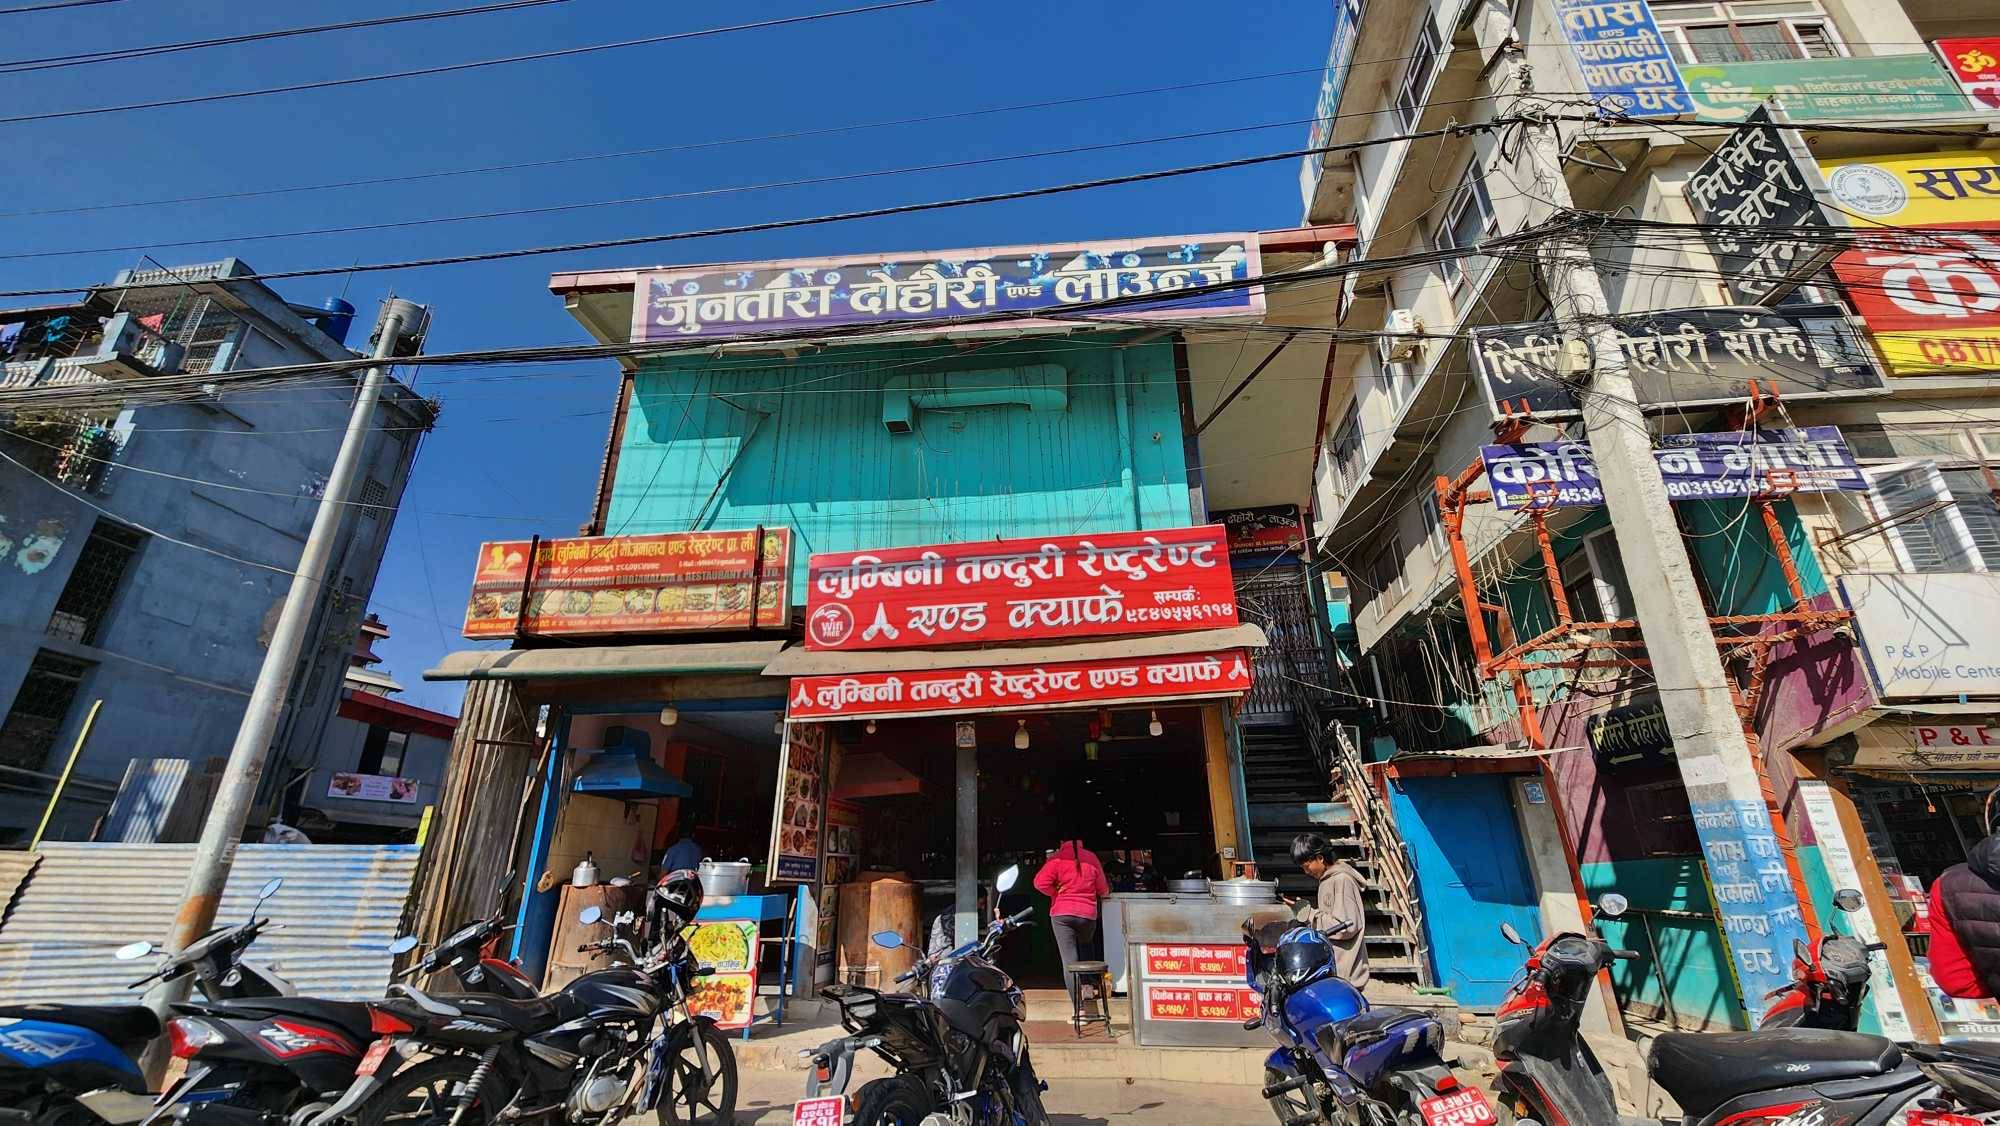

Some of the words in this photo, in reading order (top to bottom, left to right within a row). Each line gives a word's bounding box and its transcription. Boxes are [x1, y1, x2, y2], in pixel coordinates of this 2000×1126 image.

[1633, 85, 1685, 110] घर
[817, 552, 946, 598] लुम्बिनी
[956, 543, 1066, 588] तन्दुरी
[1006, 584, 1125, 630] क्याफे
[817, 676, 904, 710] लुम्बिनी
[910, 672, 983, 703] तन्दुरी
[1088, 667, 1139, 689] एण्ड
[1146, 655, 1222, 684] क्याफे
[1894, 665, 1950, 680] Mobile
